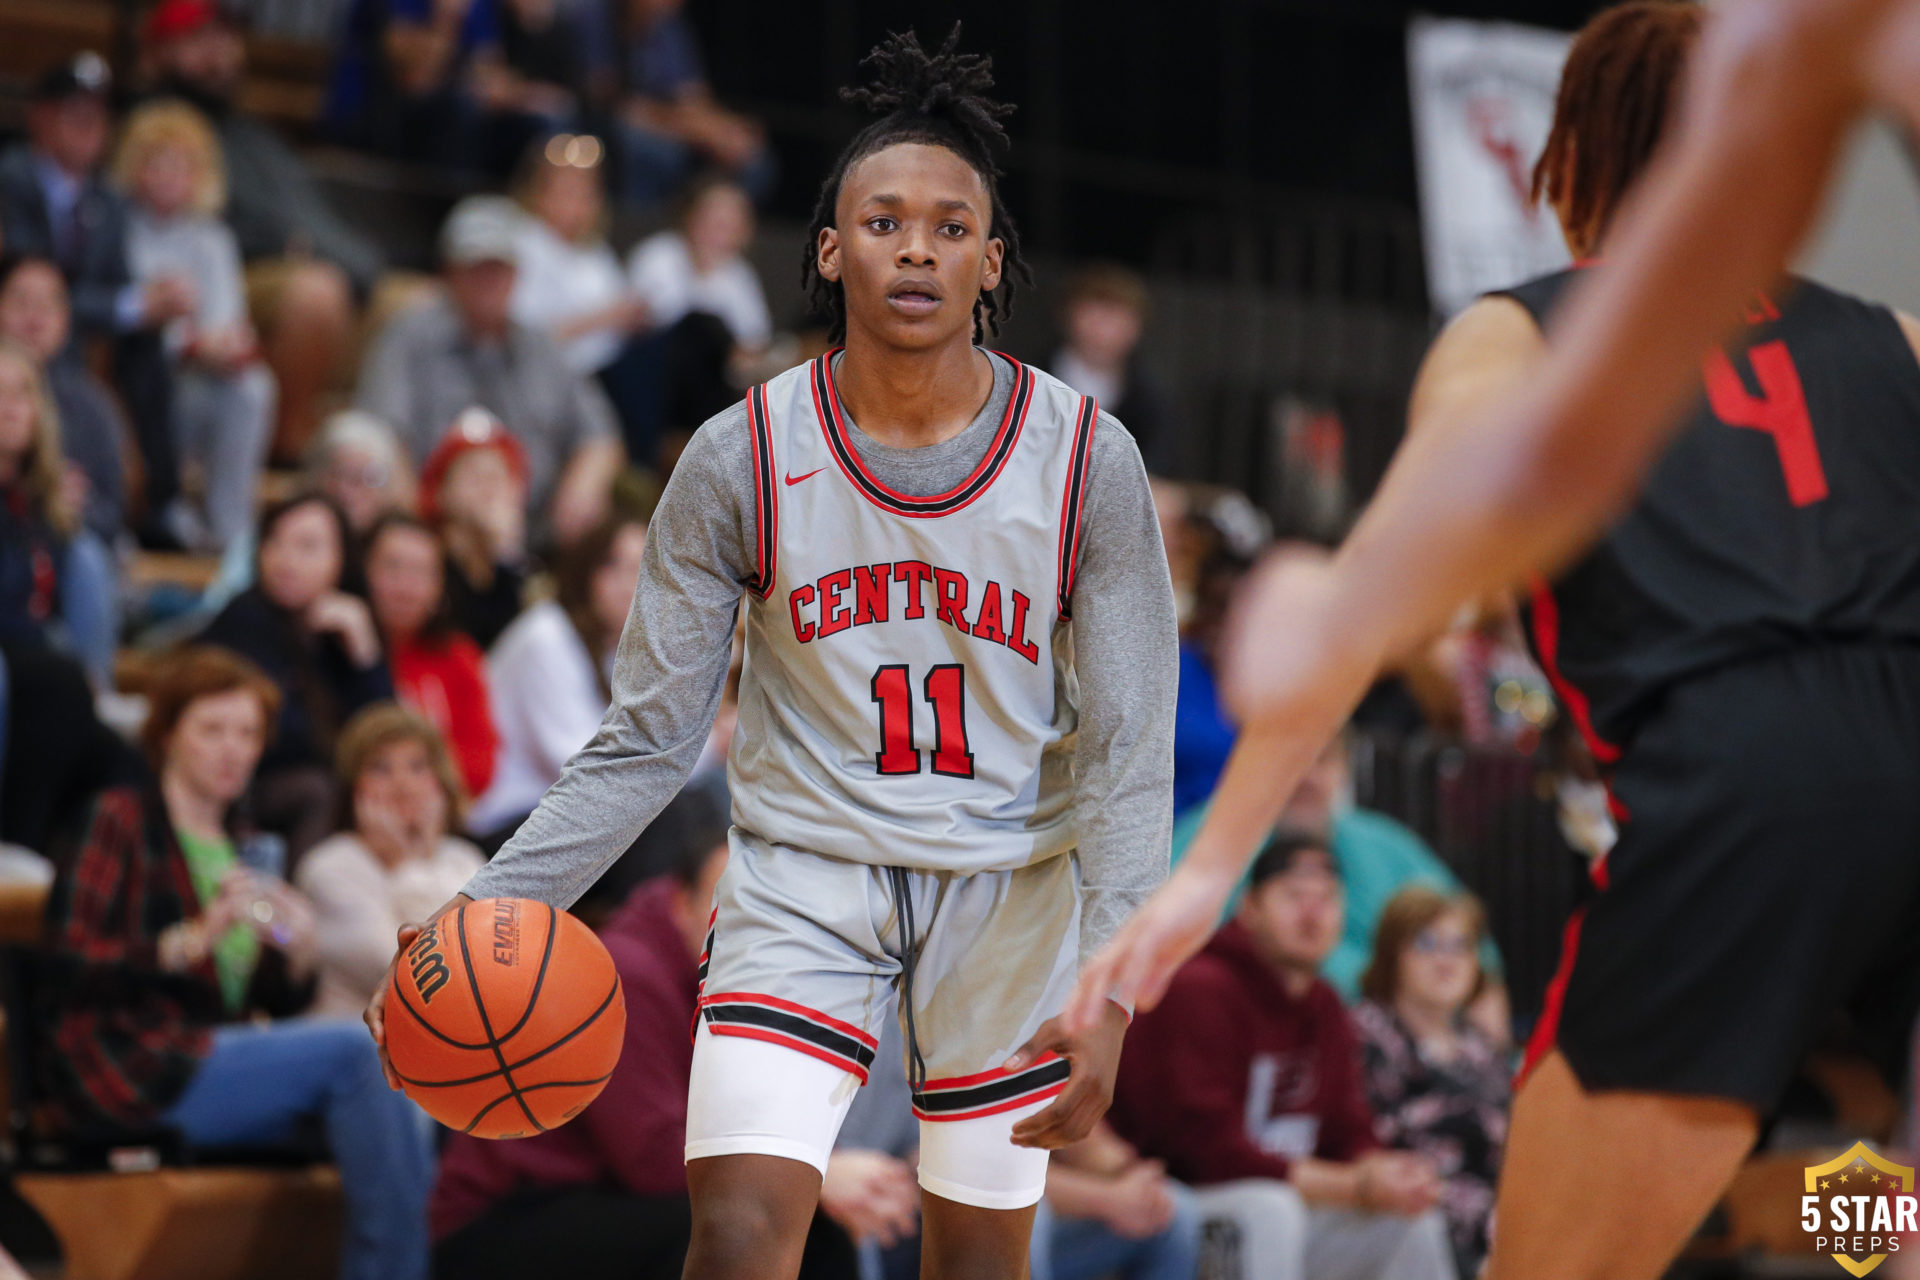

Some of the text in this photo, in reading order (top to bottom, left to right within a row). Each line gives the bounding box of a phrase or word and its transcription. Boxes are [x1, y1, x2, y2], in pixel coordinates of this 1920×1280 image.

[1701, 339, 1829, 507] 4
[789, 560, 1039, 665] CENTRAL
[870, 664, 974, 779] 11
